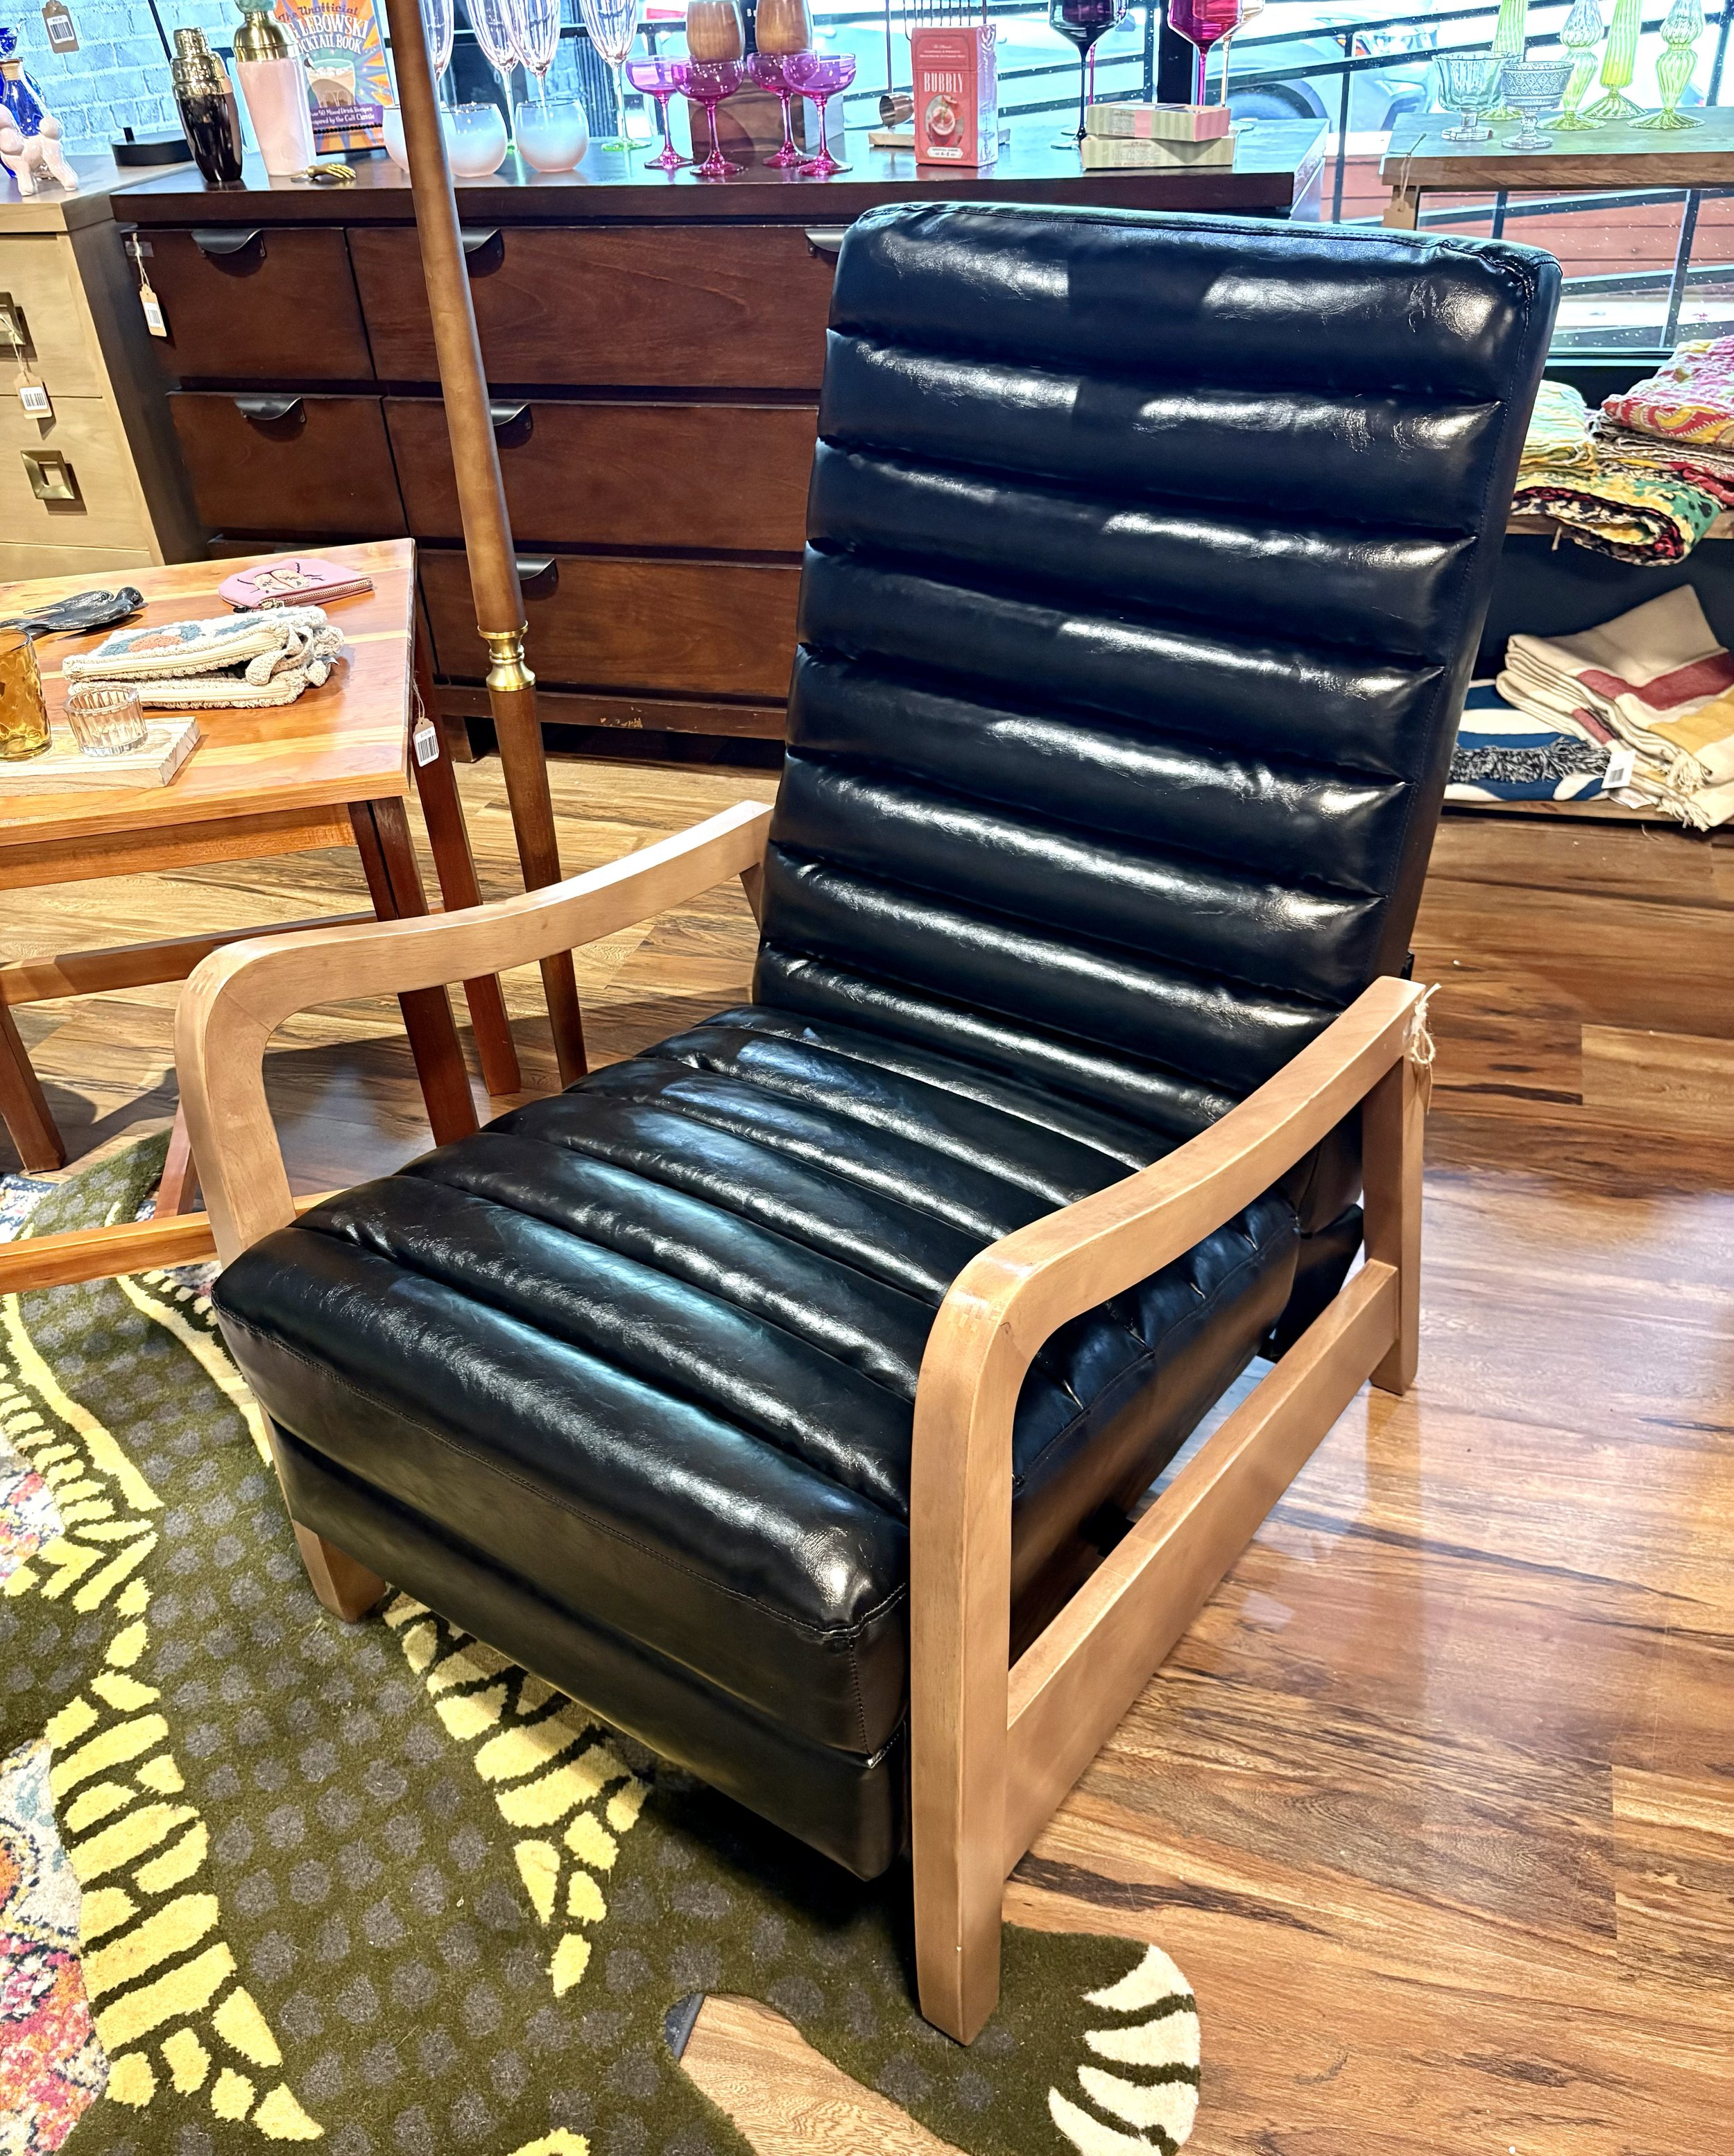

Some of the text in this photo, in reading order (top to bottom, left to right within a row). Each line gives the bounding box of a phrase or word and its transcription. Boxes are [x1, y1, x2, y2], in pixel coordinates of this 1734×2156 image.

[279, 3, 359, 23] The Unofficial
[297, 14, 369, 40] LEBOWSKI
[336, 34, 361, 55] BOOK
[924, 72, 963, 93] BUBBLY
